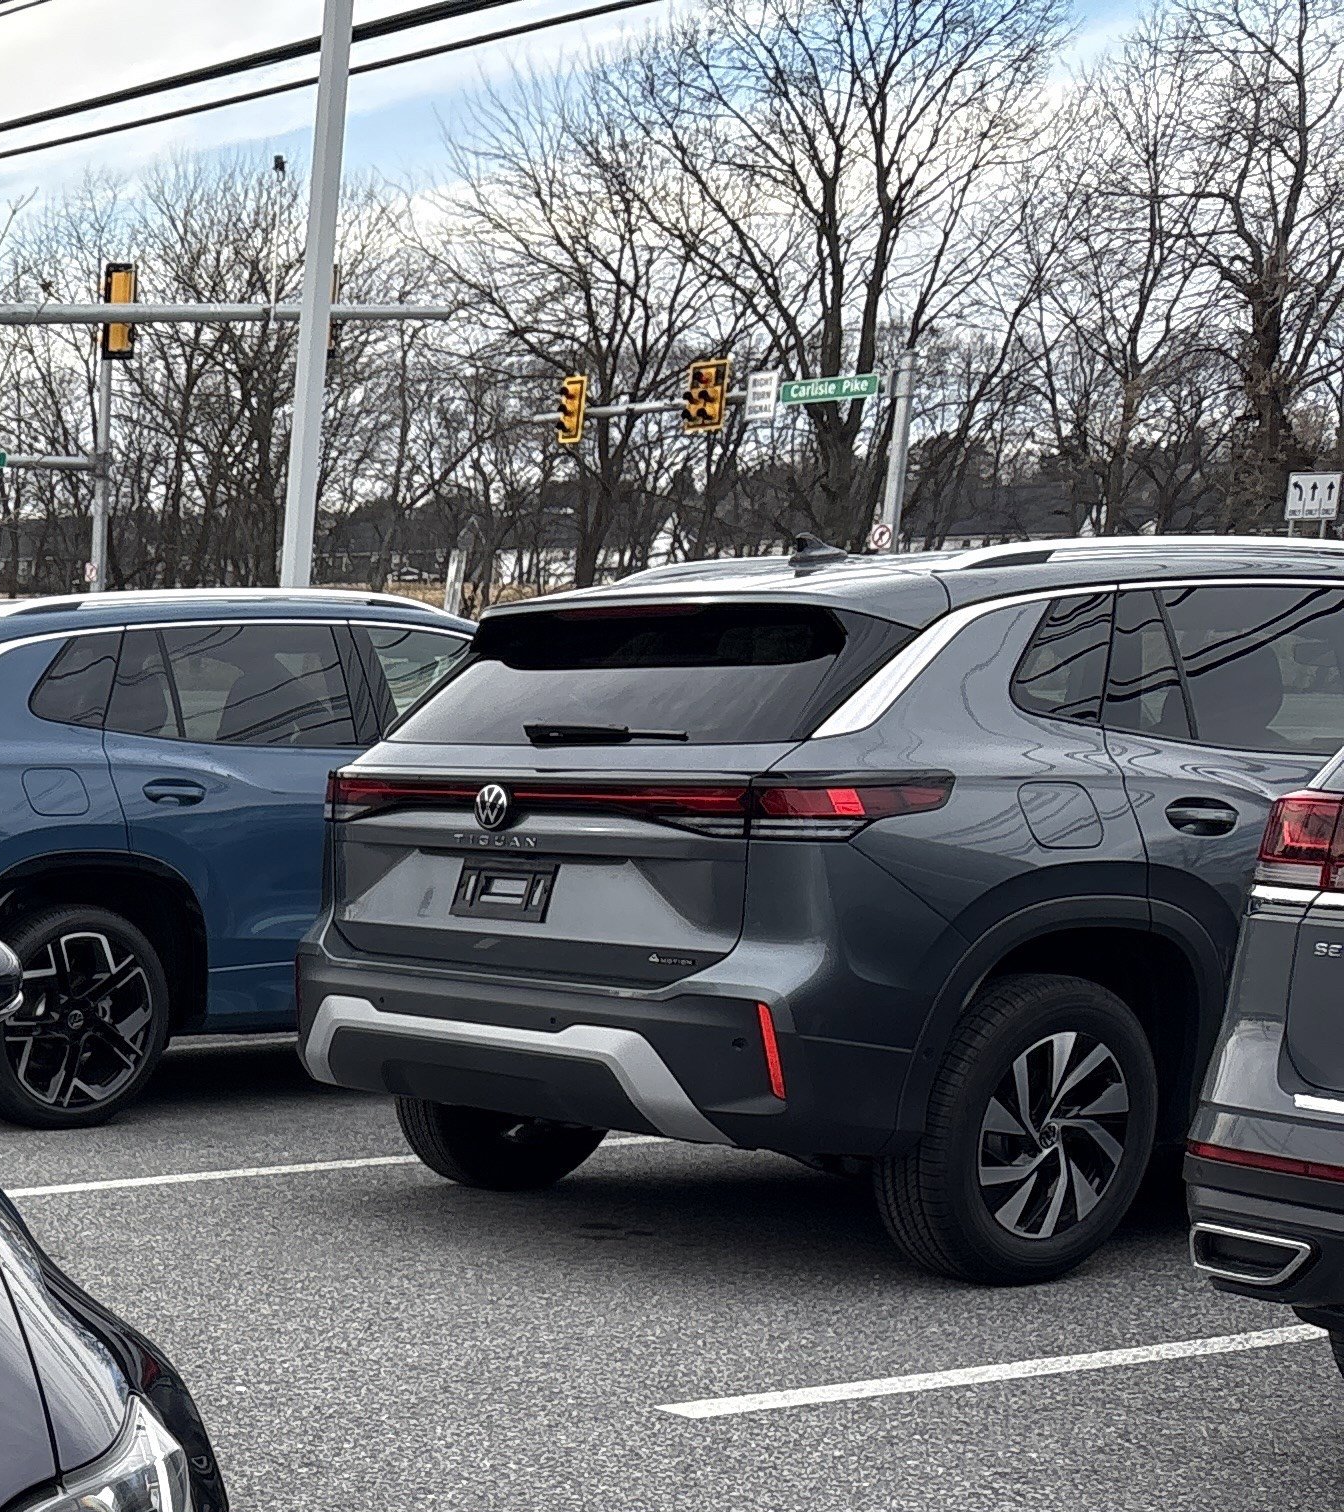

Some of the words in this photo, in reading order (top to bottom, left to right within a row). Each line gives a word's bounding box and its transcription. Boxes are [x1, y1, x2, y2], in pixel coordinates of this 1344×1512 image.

[790, 381, 837, 398] Carlisle
[842, 379, 869, 393] Pike
[453, 833, 537, 847] TIGUAN
[1313, 942, 1343, 957] SE
